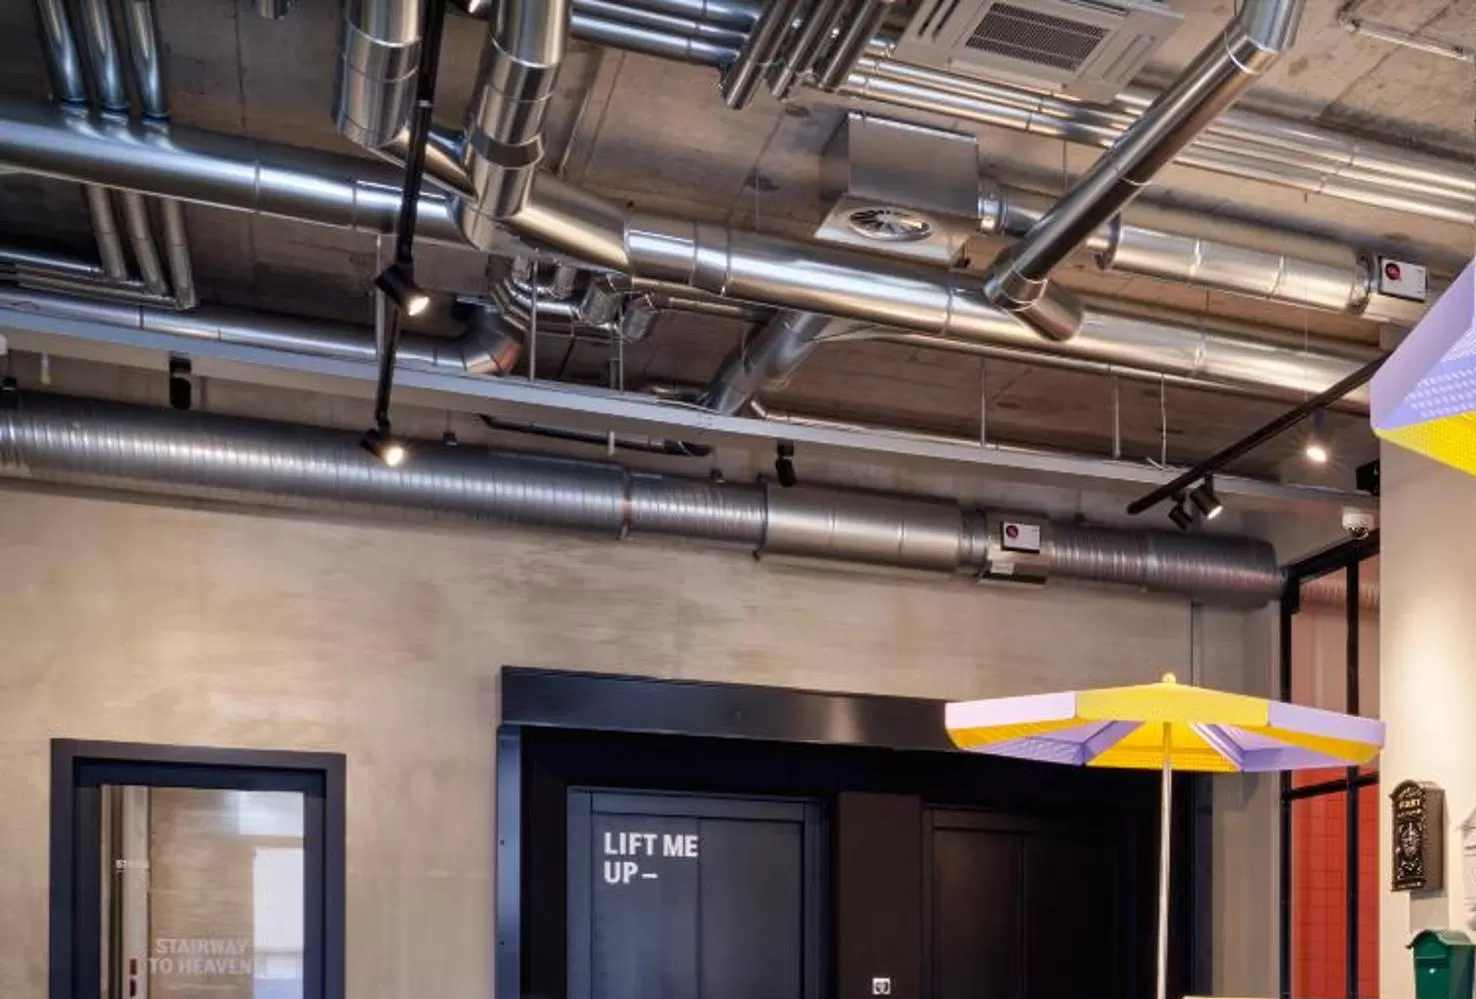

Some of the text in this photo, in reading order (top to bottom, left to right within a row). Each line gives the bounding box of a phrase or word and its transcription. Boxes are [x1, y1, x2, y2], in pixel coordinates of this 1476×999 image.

[604, 831, 699, 857] LIFT ME
[155, 937, 249, 956] STAIRWAY
[149, 957, 253, 976] TO HEAVEN
